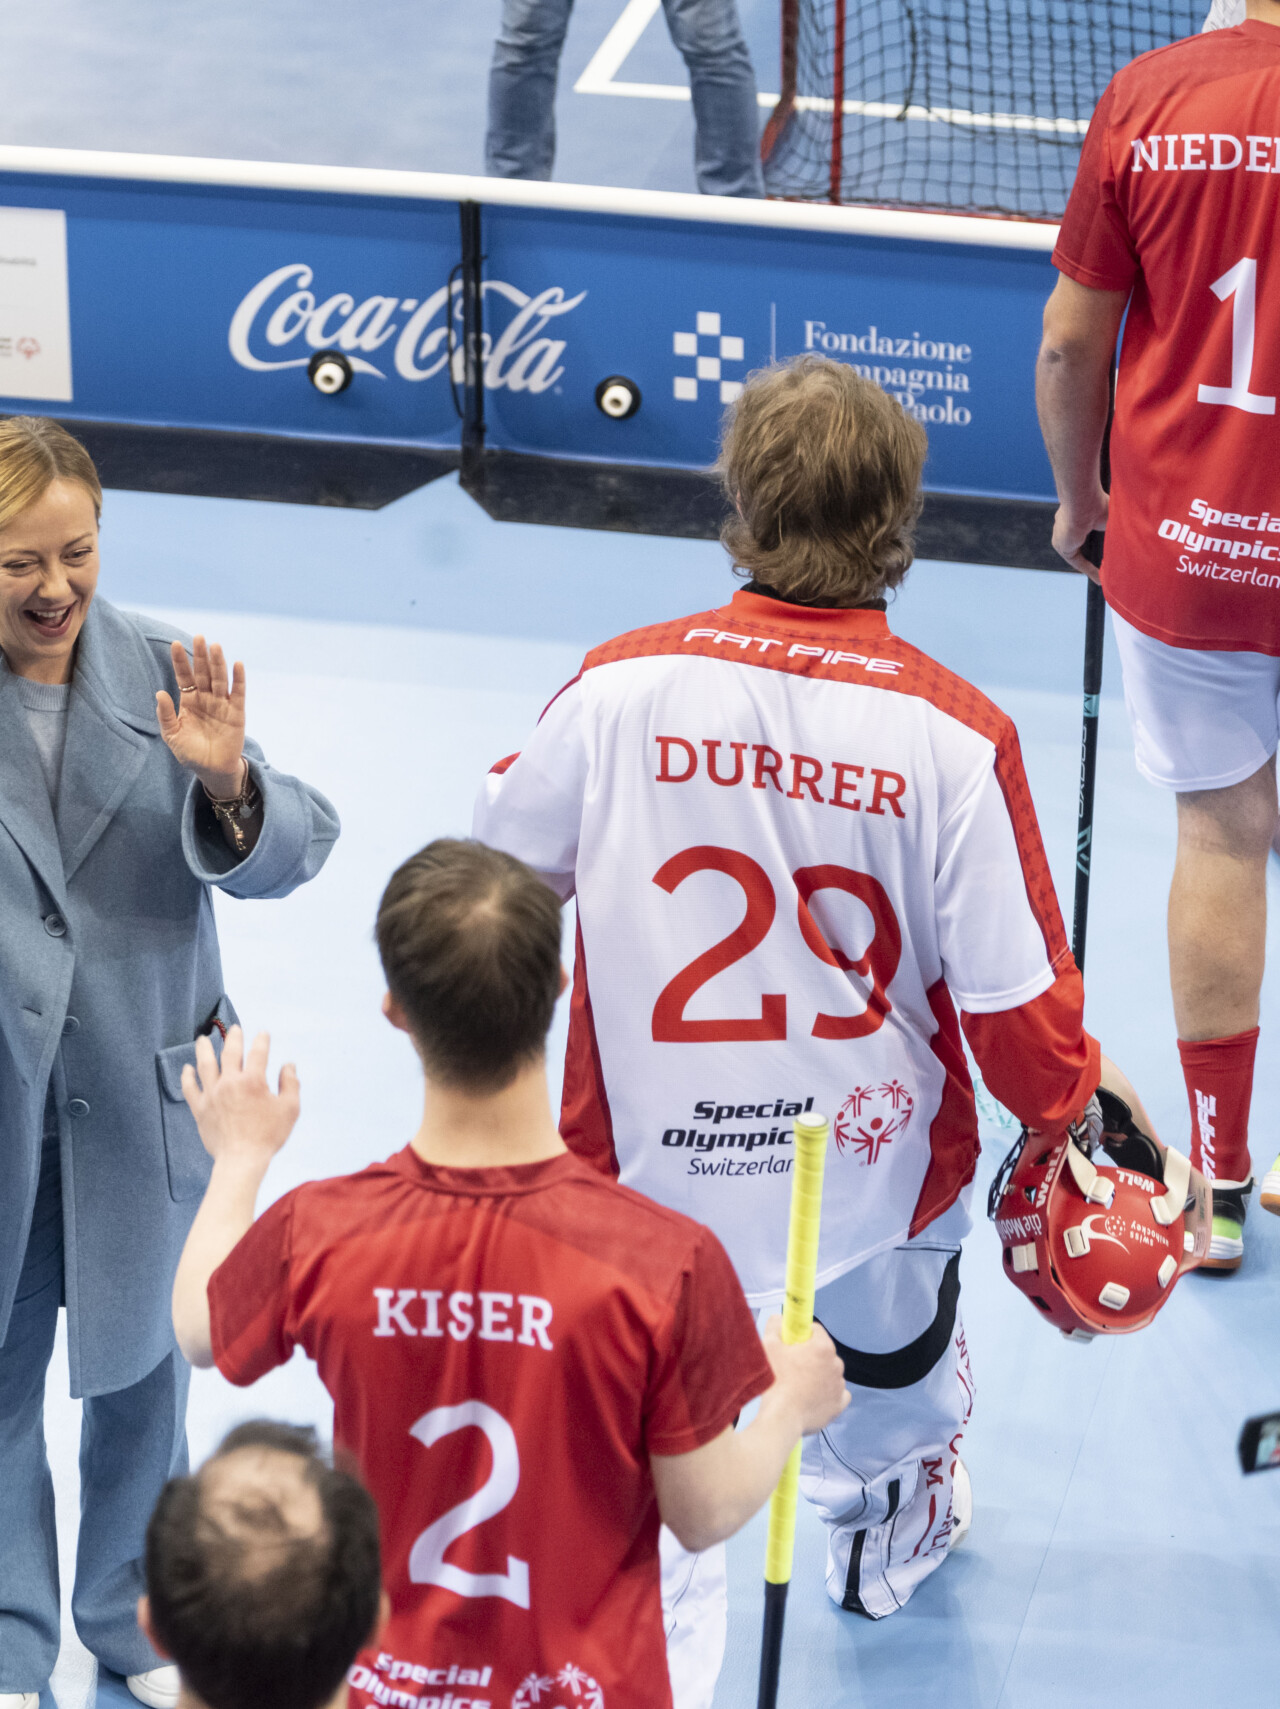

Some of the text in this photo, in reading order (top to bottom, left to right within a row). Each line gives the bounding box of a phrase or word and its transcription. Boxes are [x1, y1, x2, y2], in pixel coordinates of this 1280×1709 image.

[1131, 133, 1280, 173] NIEDE
[804, 320, 972, 363] Fondazione
[1197, 257, 1276, 415] 1
[850, 364, 970, 397] mpagnia
[683, 628, 904, 675] FAT PIPE
[655, 736, 906, 819] DURRER
[652, 845, 902, 1043] 29
[693, 1097, 815, 1124] Special
[661, 1127, 796, 1152] Olympic
[373, 1287, 553, 1350] KISER
[409, 1399, 530, 1610] 2
[374, 1652, 492, 1687] Special
